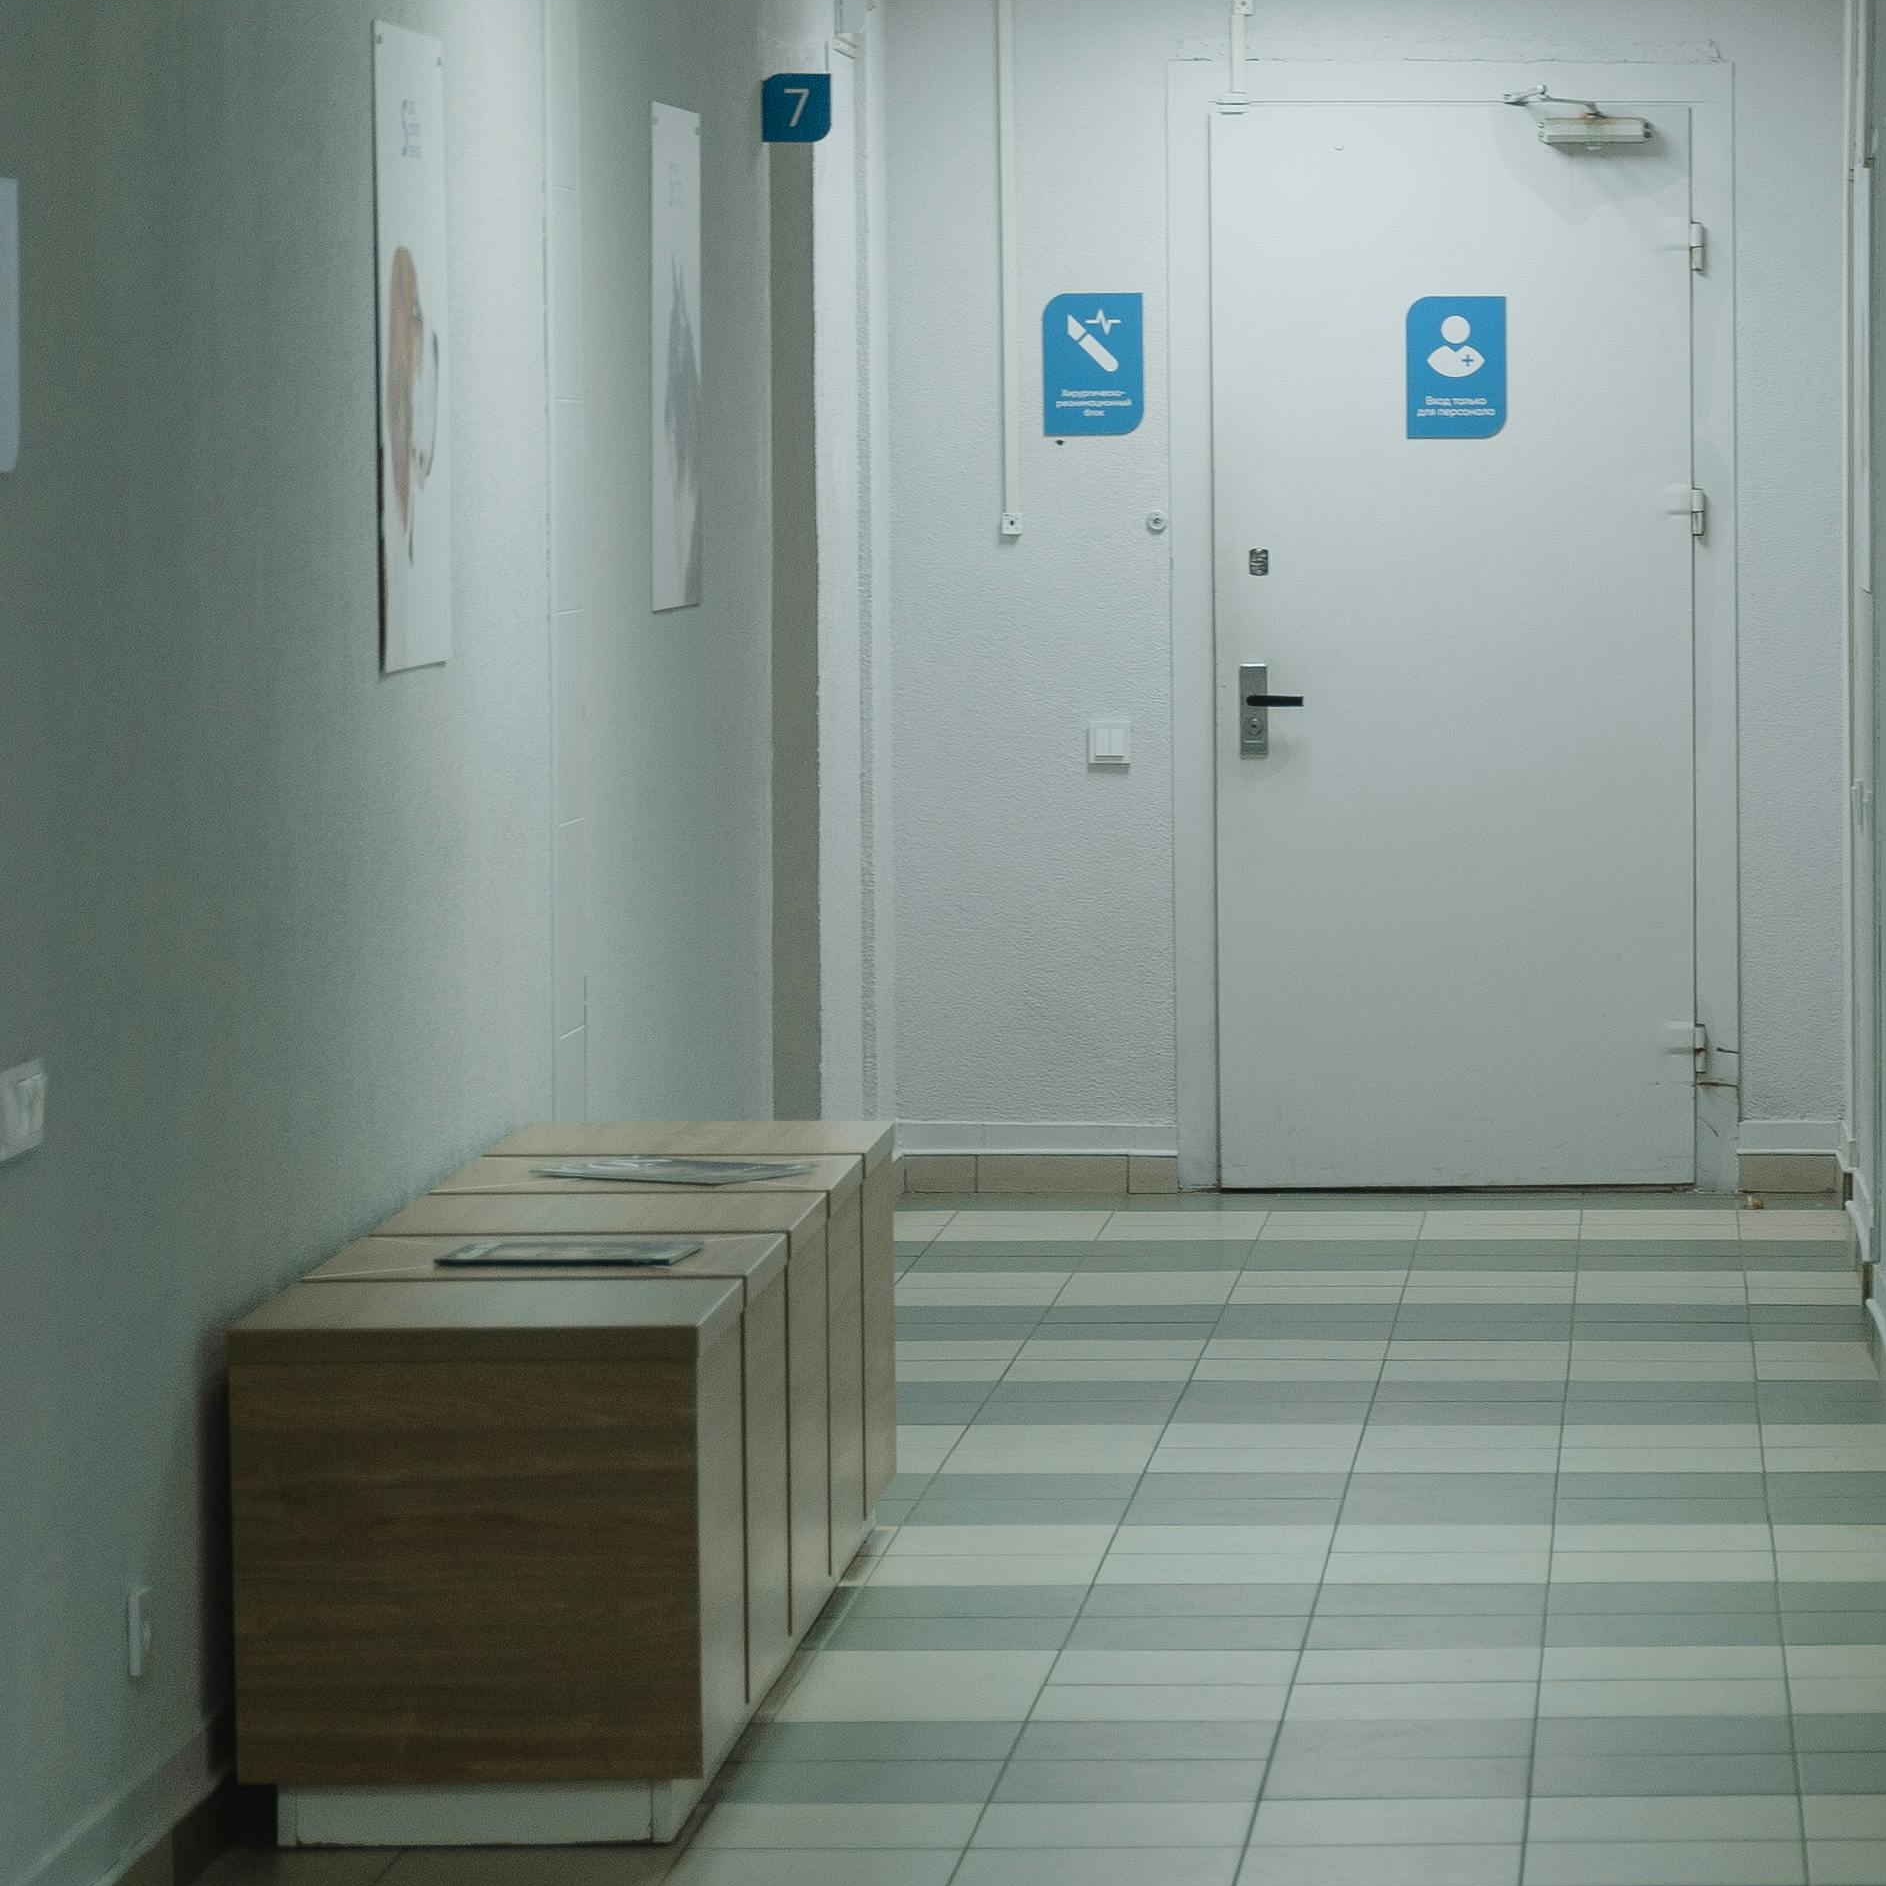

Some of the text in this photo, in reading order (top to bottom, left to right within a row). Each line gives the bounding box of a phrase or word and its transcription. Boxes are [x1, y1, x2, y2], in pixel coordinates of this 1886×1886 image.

[783, 88, 810, 128] 7
[1424, 395, 1488, 406] Вход только
[1416, 408, 1496, 418] для персонала
